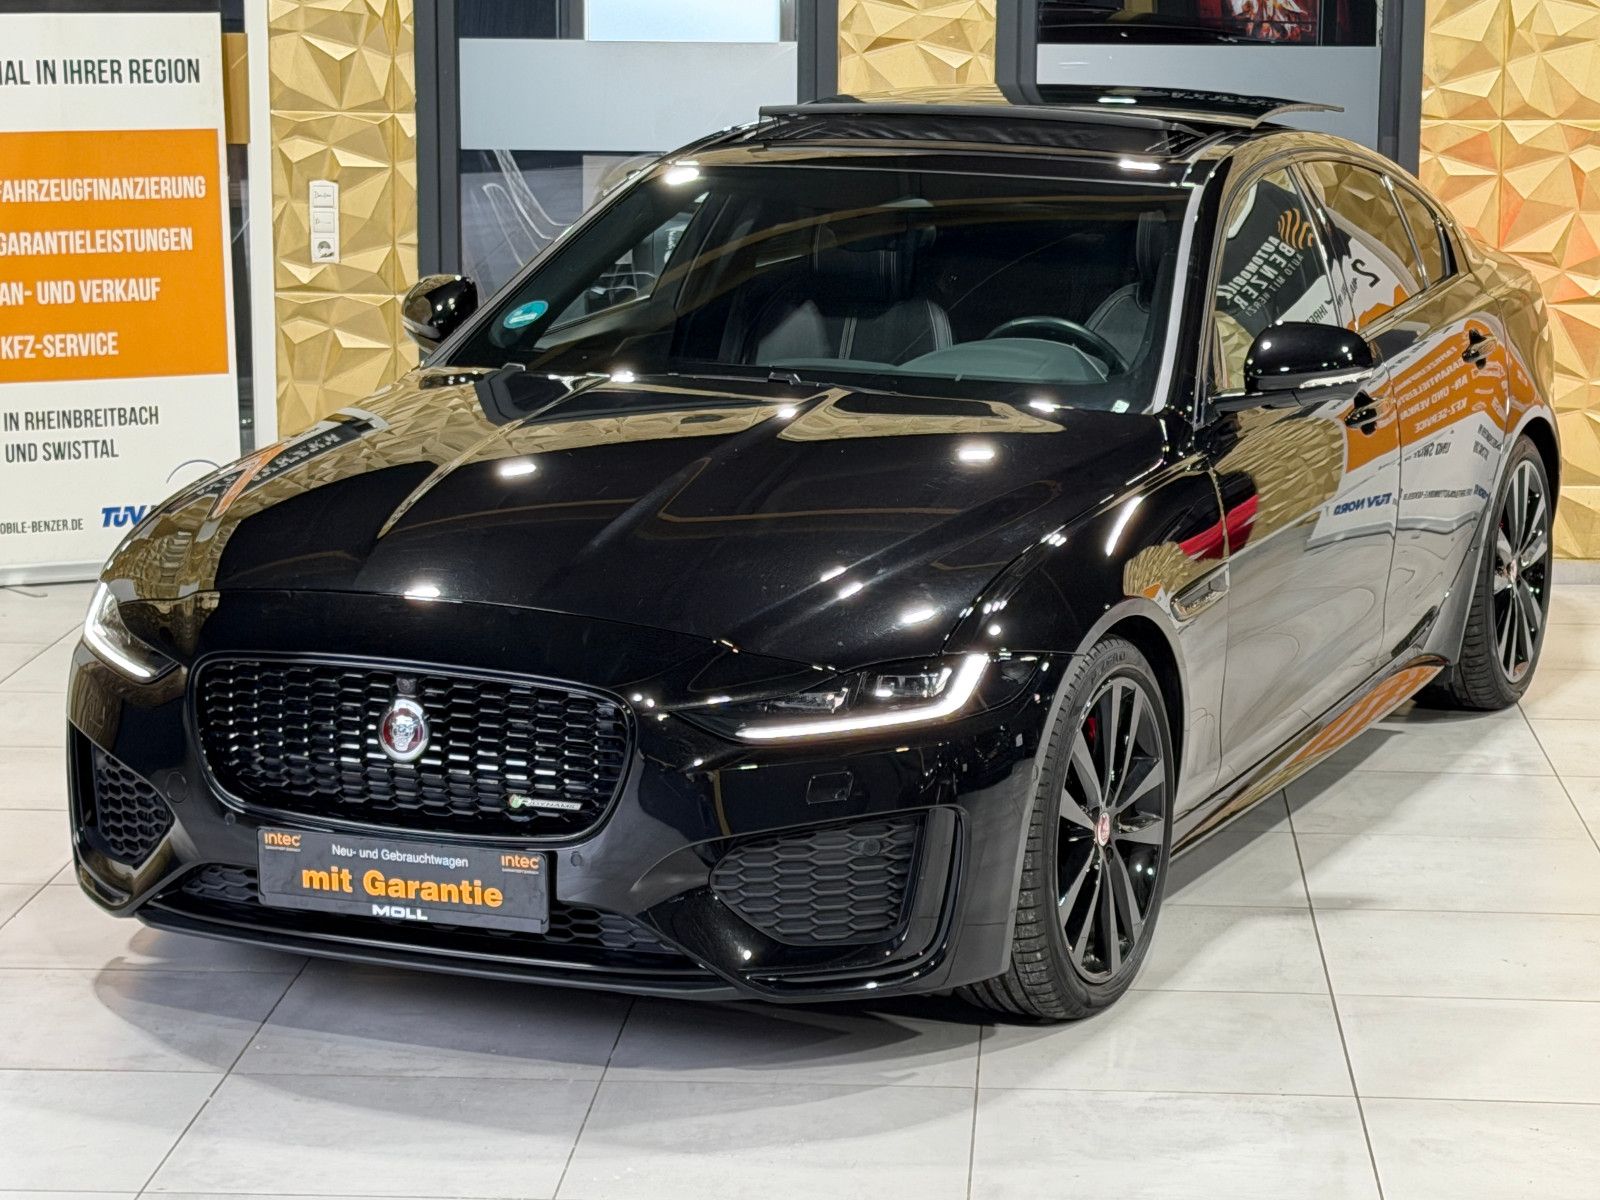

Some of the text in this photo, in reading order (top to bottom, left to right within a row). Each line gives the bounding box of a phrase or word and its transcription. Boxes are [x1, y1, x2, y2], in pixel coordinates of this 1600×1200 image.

[36, 59, 57, 85] IN
[63, 59, 123, 84] IHRER
[129, 58, 200, 84] REGION
[0, 227, 193, 256] GARANTIELEISTUNGEN
[0, 278, 160, 306] AN- UND VERKAUF
[1, 331, 119, 360] KFZ-SERVICE
[3, 405, 159, 432] IN RHEINBREITBACH
[5, 438, 119, 463] UND SWISTTAL
[331, 844, 469, 870] Neu- und Gebrauchtwagen
[302, 866, 504, 908] mit Garantie
[371, 904, 428, 921] MOLL
